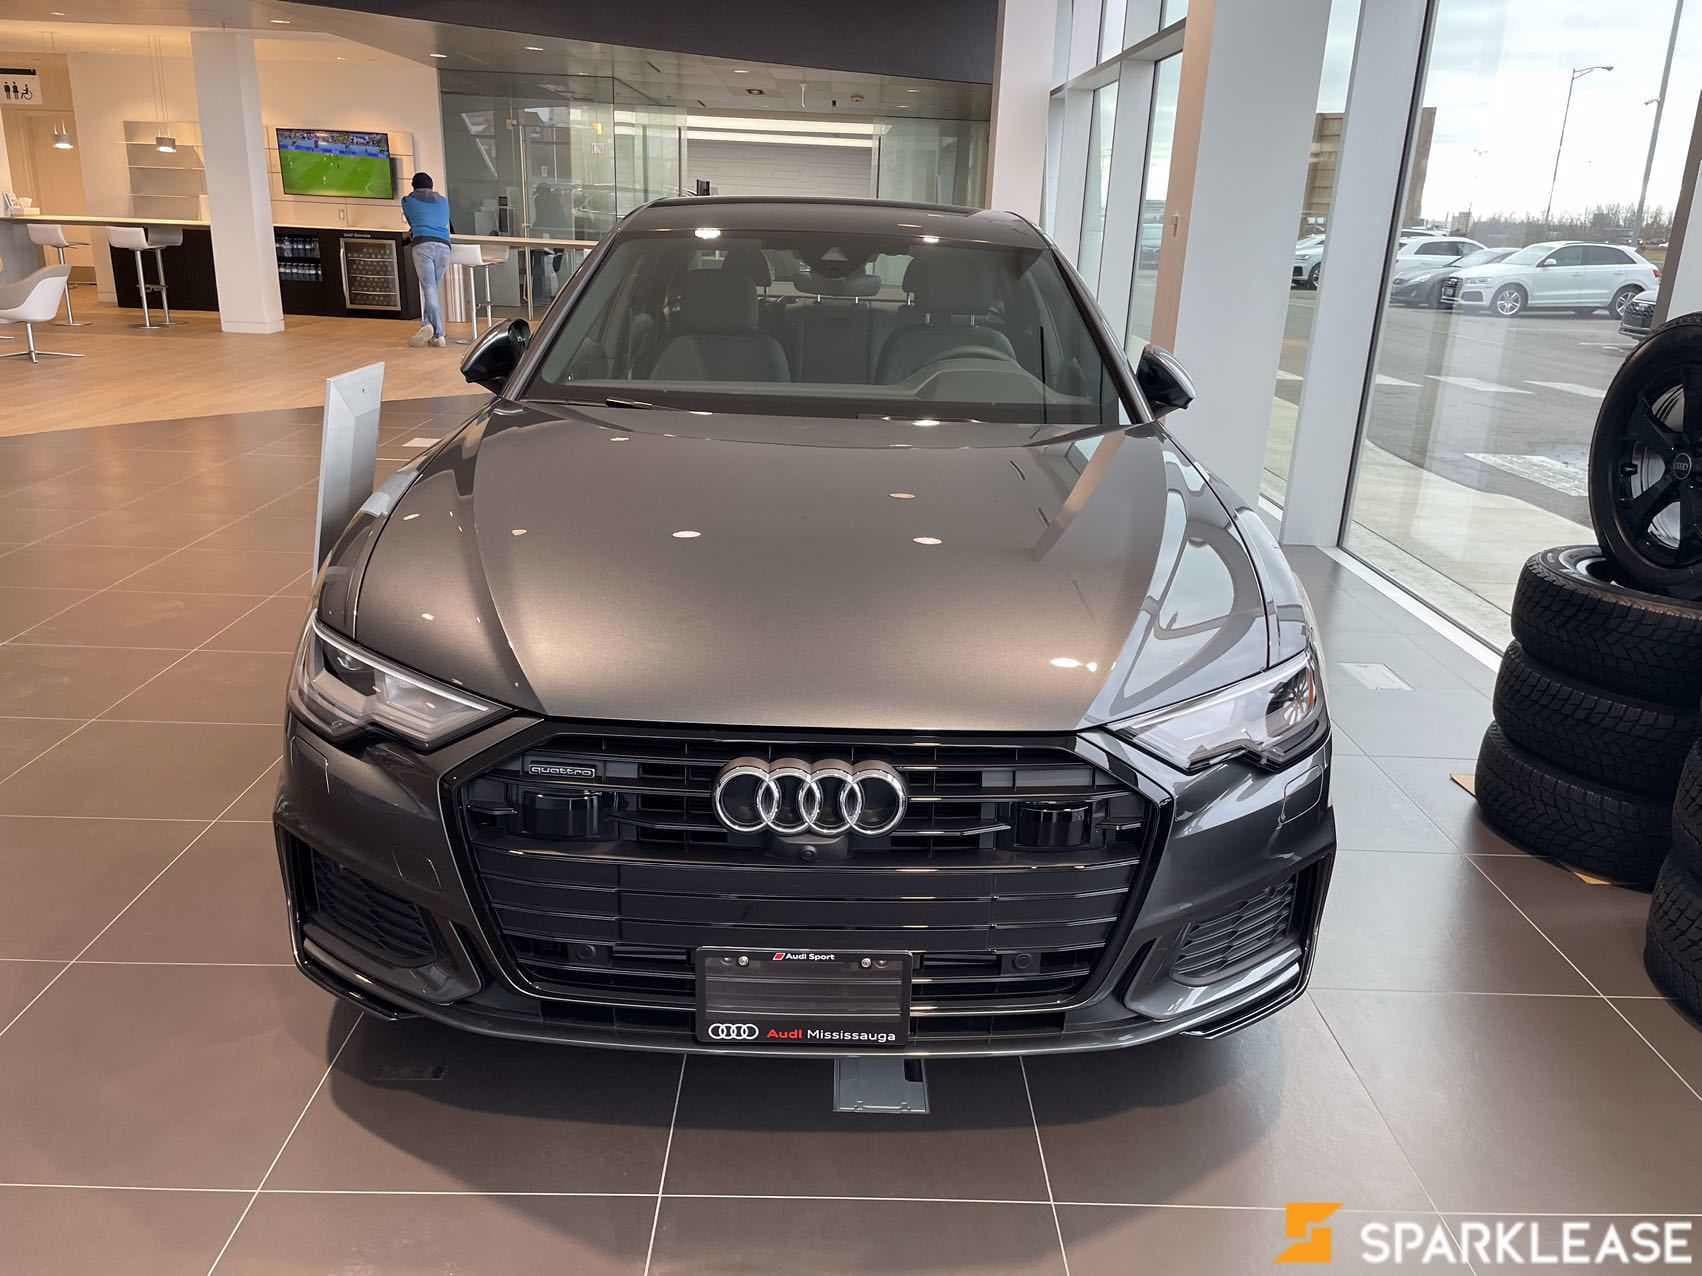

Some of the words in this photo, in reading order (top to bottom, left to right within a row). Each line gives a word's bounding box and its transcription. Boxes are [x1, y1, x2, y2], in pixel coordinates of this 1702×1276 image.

[530, 766, 592, 777] quattro
[808, 953, 835, 961] Sport
[767, 1029, 803, 1039] Audi
[807, 1029, 896, 1043] Mississauga
